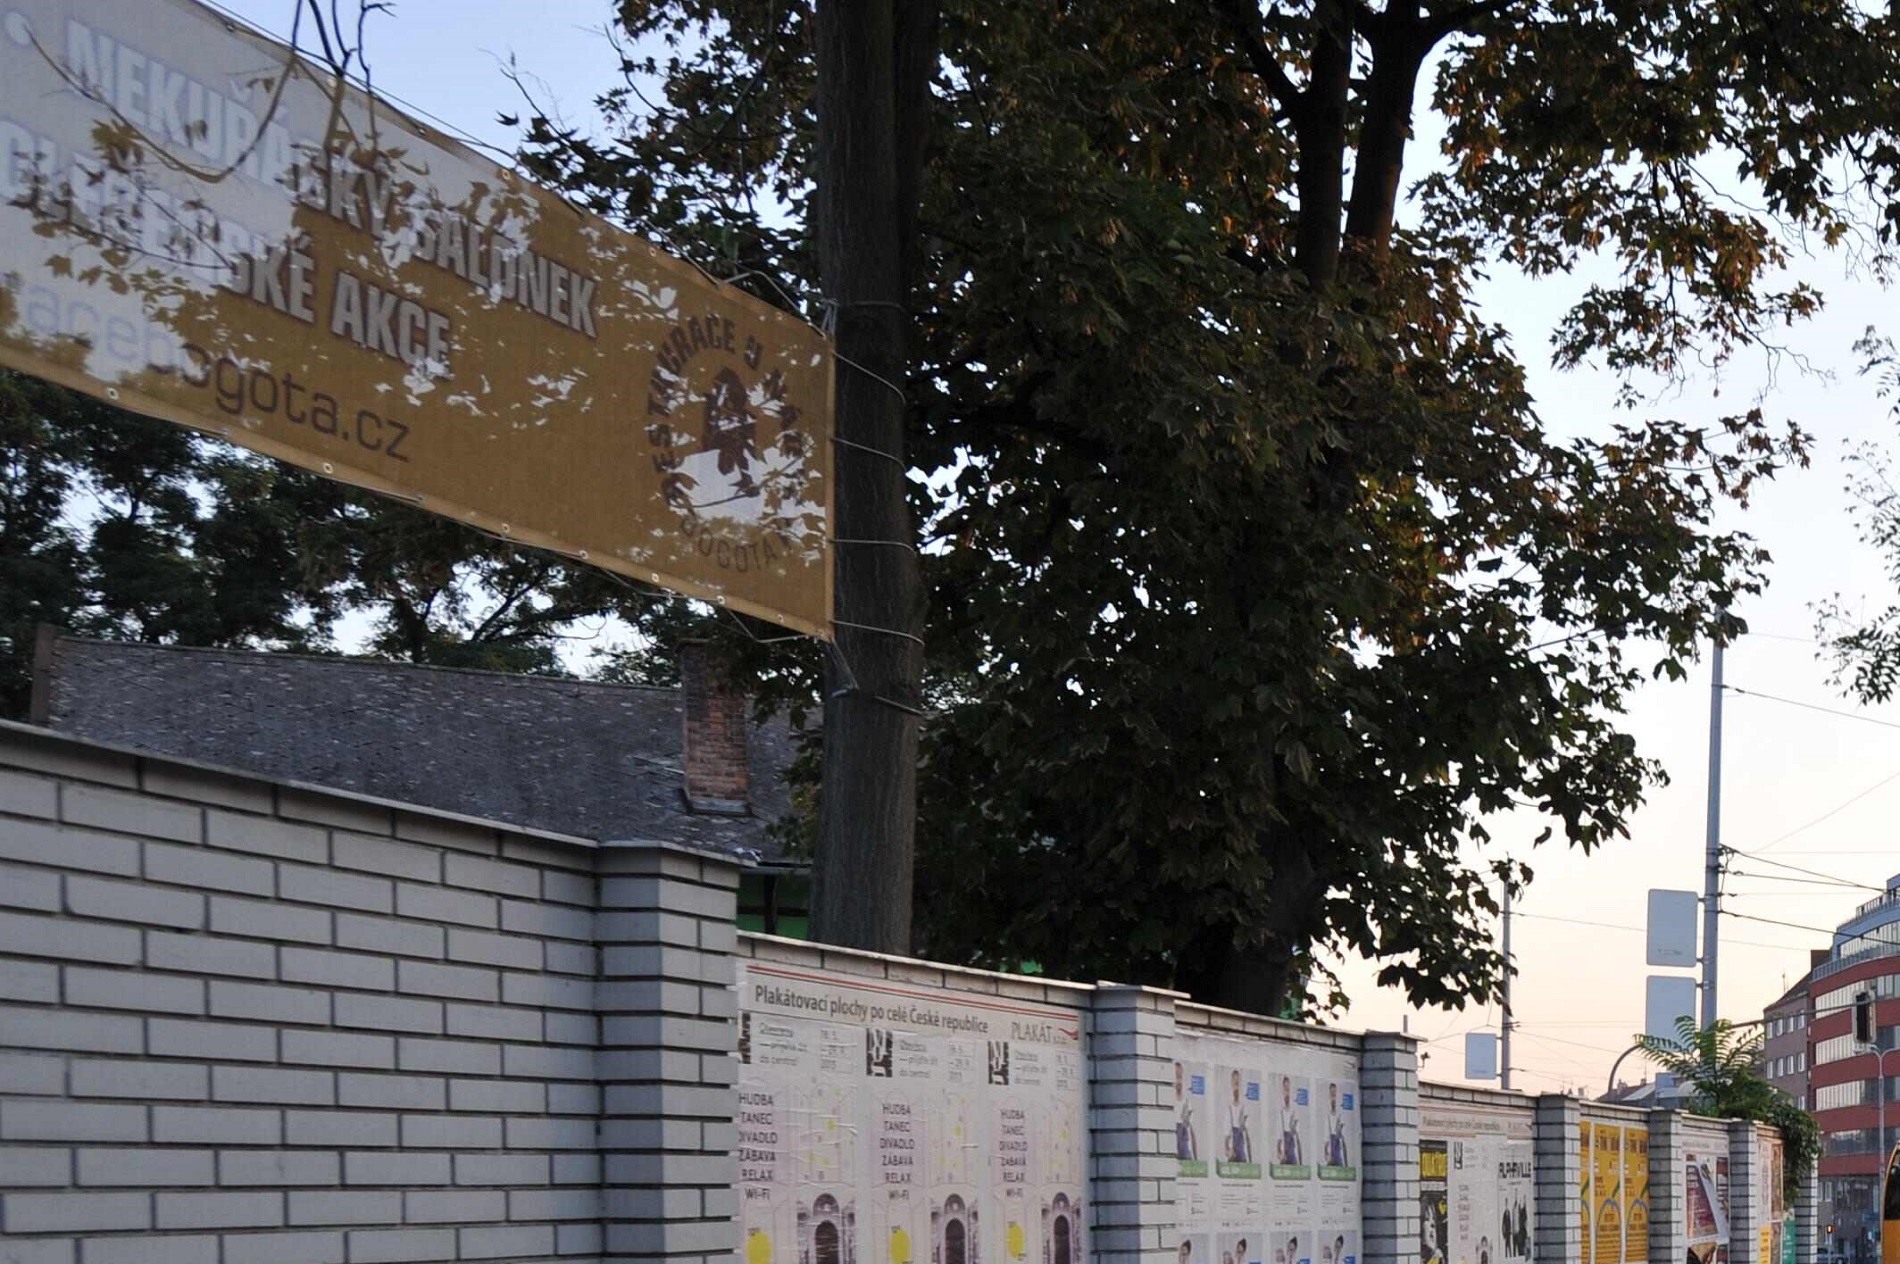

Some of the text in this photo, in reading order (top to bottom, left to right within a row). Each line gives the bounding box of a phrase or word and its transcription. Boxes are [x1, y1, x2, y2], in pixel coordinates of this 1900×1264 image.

[330, 271, 450, 380] AKCE
[755, 984, 828, 1011] Plakátovací
[830, 996, 868, 1021] plochy
[871, 1006, 884, 1022] po
[886, 1005, 908, 1021] celé
[909, 1004, 940, 1028] České
[942, 1013, 989, 1034] republice
[1012, 1021, 1053, 1044] PLAKÁT
[738, 1093, 774, 1107] HUDBA
[882, 1103, 911, 1115] HUDBA
[741, 1111, 773, 1125] TANEC
[883, 1120, 911, 1133] TANEC
[738, 1131, 778, 1144] DIVADLO
[879, 1137, 915, 1150] DIVADLO
[742, 1169, 773, 1181] RELAX
[885, 1172, 912, 1184] RELAX
[1003, 1172, 1025, 1183] RELAX
